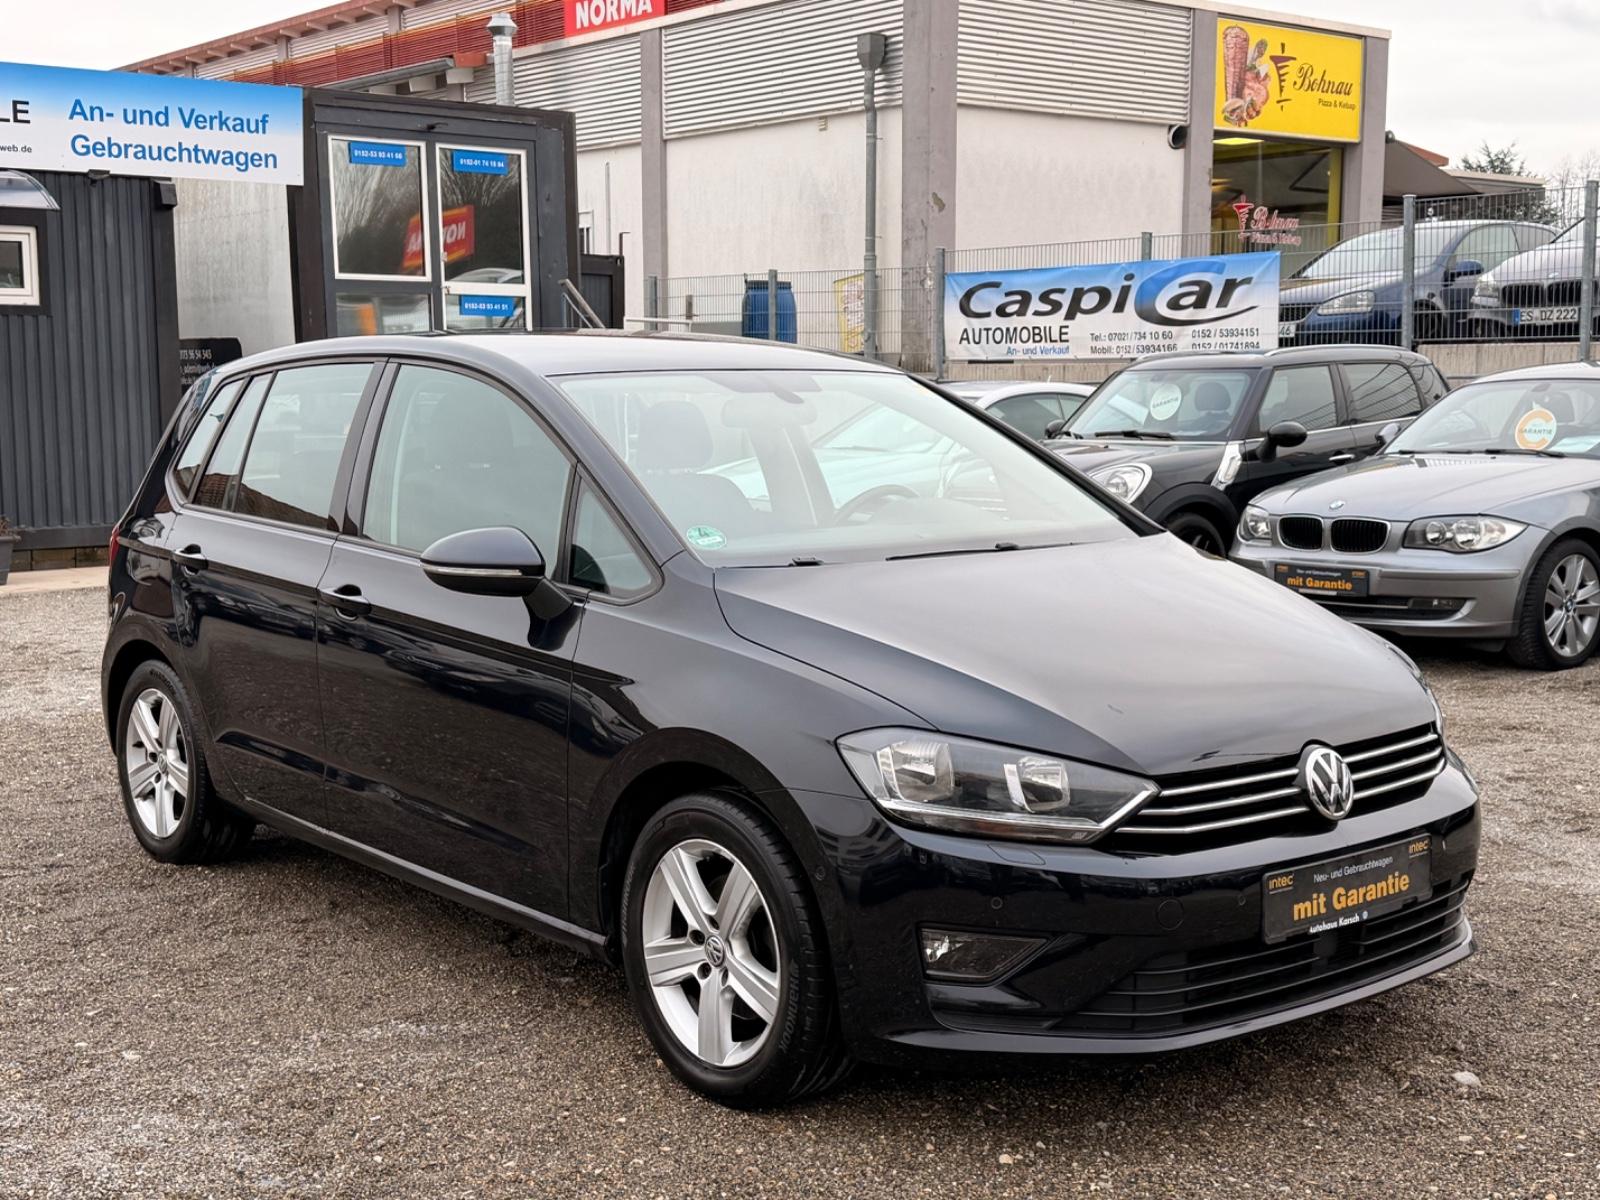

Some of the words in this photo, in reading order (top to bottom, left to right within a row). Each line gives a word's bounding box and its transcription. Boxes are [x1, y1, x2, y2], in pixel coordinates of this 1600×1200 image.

[575, 0, 652, 29] NORMA
[1293, 63, 1353, 96] Bohnau
[69, 99, 114, 121] An-
[123, 106, 169, 127] und
[178, 107, 269, 134] Verkauf
[70, 134, 278, 172] Gebrauchtwagen
[959, 260, 1259, 327] CaspiCar
[1556, 308, 1577, 320] 222
[959, 325, 1070, 345] AUTOMOBILE
[1090, 332, 1107, 342] Tel.:
[1149, 331, 1159, 340] 10
[1162, 330, 1173, 340] 60
[1192, 329, 1212, 338] 0152
[1219, 327, 1259, 338] 53934151
[1006, 346, 1020, 356] An-
[1022, 346, 1037, 355] und
[1039, 345, 1070, 355] Verkauf
[1287, 575, 1303, 587] mit
[1306, 577, 1353, 590] Garantie
[1314, 872, 1330, 884] Neu-
[1330, 867, 1343, 880] und
[1343, 856, 1394, 877] Gebrauchtwagen
[1293, 892, 1327, 921] mit
[1332, 871, 1410, 911] Garantie
[1338, 913, 1360, 926] Karsch
